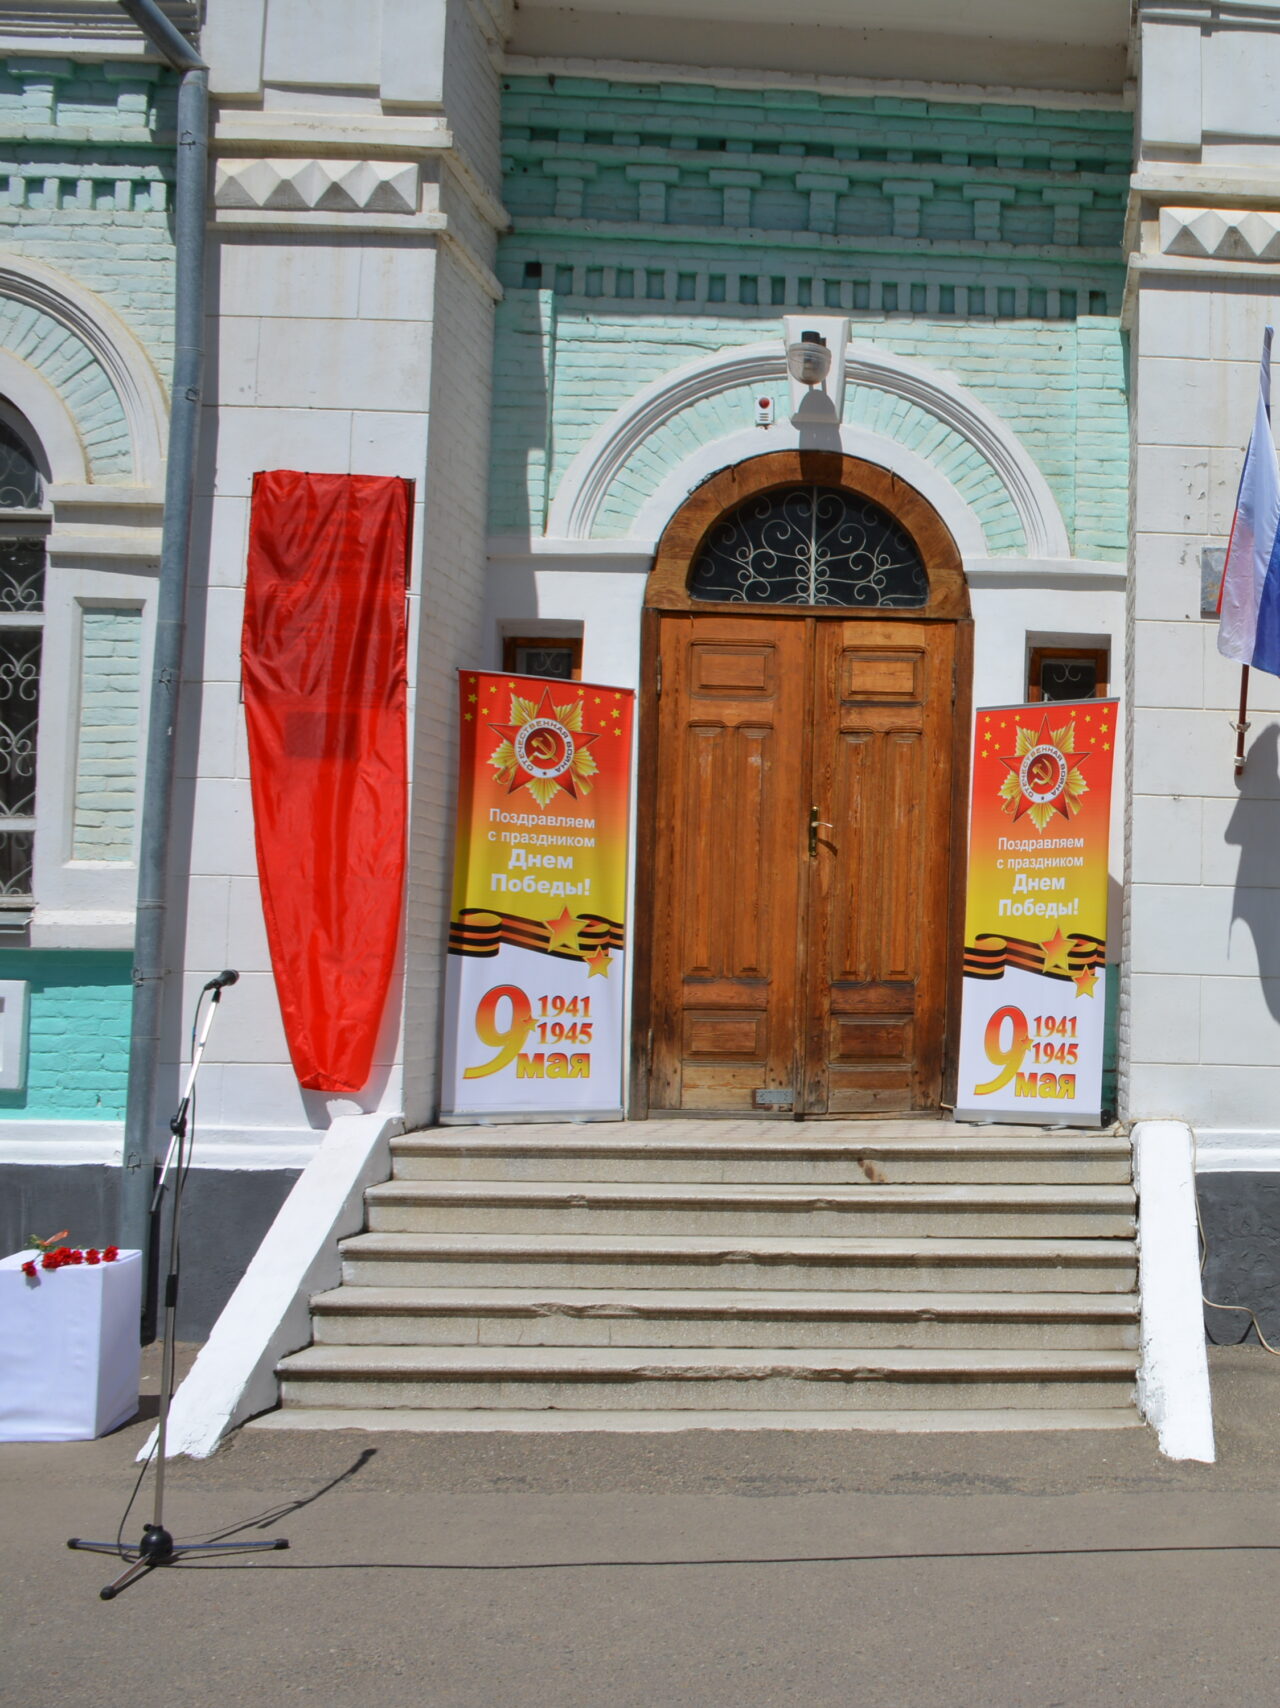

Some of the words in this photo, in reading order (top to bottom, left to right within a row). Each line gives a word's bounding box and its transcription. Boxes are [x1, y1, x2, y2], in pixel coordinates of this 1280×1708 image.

[489, 808, 596, 829] Поздравляем
[488, 831, 497, 841] с
[501, 831, 596, 847] праздником
[998, 837, 1084, 852] Поздравляем
[508, 848, 574, 870] Днем
[996, 858, 1004, 869] с
[1007, 856, 1084, 871] праздником
[490, 873, 592, 898] Победы!
[1012, 873, 1066, 894] Днем
[998, 897, 1079, 919] Победы!
[537, 995, 592, 1018] 1941
[463, 983, 532, 1079] 9
[537, 1022, 593, 1045] 1945
[1033, 1015, 1078, 1038] 1941
[973, 1004, 1029, 1096] 9
[1032, 1042, 1079, 1065] 1945
[516, 1052, 590, 1079] мая
[1014, 1071, 1076, 1099] мая
